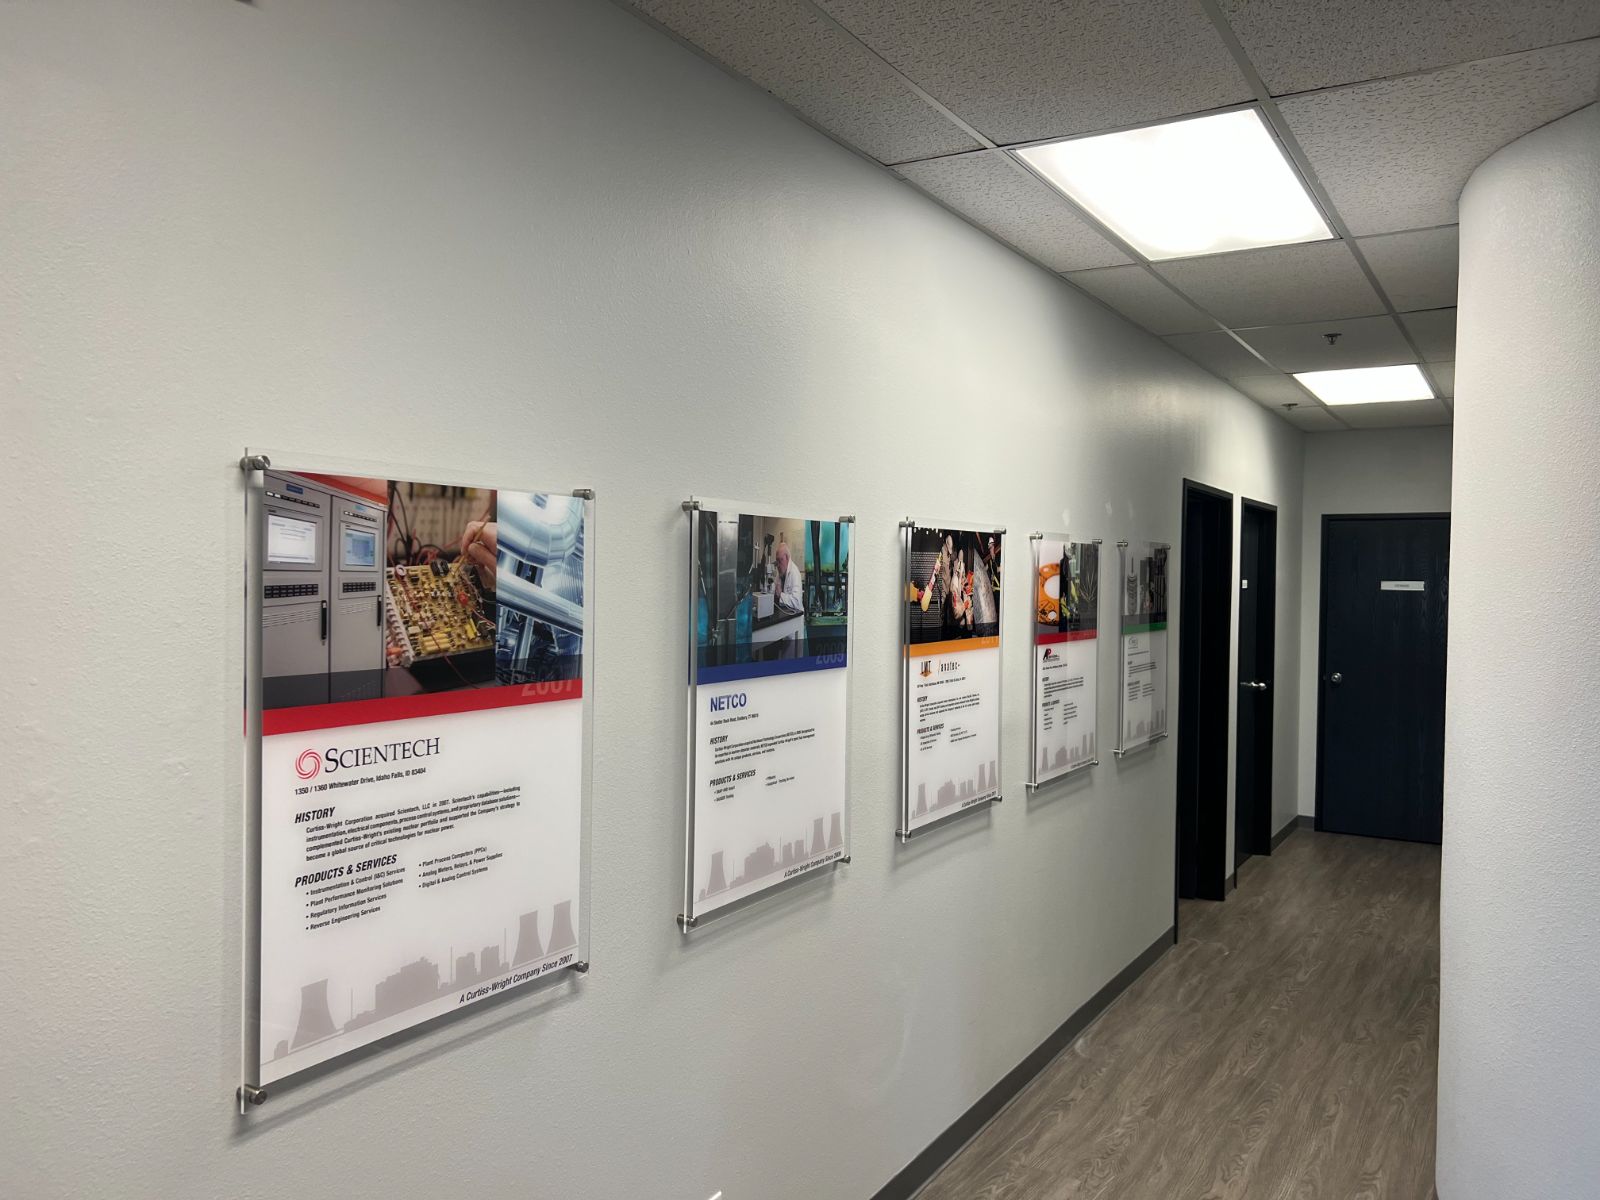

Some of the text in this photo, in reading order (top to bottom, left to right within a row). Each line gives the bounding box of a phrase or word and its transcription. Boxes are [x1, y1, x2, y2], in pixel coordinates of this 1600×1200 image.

[710, 693, 746, 712] NETCO
[710, 735, 728, 744] HISTORY
[329, 778, 360, 790] Whitewater
[360, 776, 376, 784] Drive,
[376, 774, 390, 782] Idaho
[391, 772, 404, 780] Falls,
[710, 774, 732, 787] PRODUCTS
[294, 806, 336, 824] HISTORY
[306, 822, 342, 834] Curtiss-Wright
[345, 816, 373, 825] Corporation
[375, 811, 396, 820] acquired
[397, 806, 420, 815] Scientech,
[306, 830, 347, 842] instrumentation,
[348, 825, 370, 834] electrical
[370, 818, 398, 829] components,
[399, 816, 416, 824] process
[306, 840, 342, 852] complemented
[344, 832, 382, 844] Curtiss-Wright's
[384, 827, 402, 836] existing
[402, 823, 420, 831] nuclear
[306, 853, 326, 861] become
[332, 848, 347, 856] global
[348, 844, 364, 852] source
[371, 838, 388, 847] critical
[294, 854, 398, 888] PRODUCTS & SERVICES
[310, 882, 350, 896] Instrumentation
[356, 874, 372, 884] Control
[386, 868, 406, 876] Services
[422, 880, 436, 888] Digital
[456, 870, 472, 879] Control
[472, 866, 488, 875] Systems
[310, 878, 404, 907] Plant Performance Monitoring Solutions
[310, 894, 387, 918] Regulatory Information Services
[310, 906, 380, 930] Reverse Engineering Services
[460, 954, 573, 1004] A Curtiss-Wright Company Since 2007
